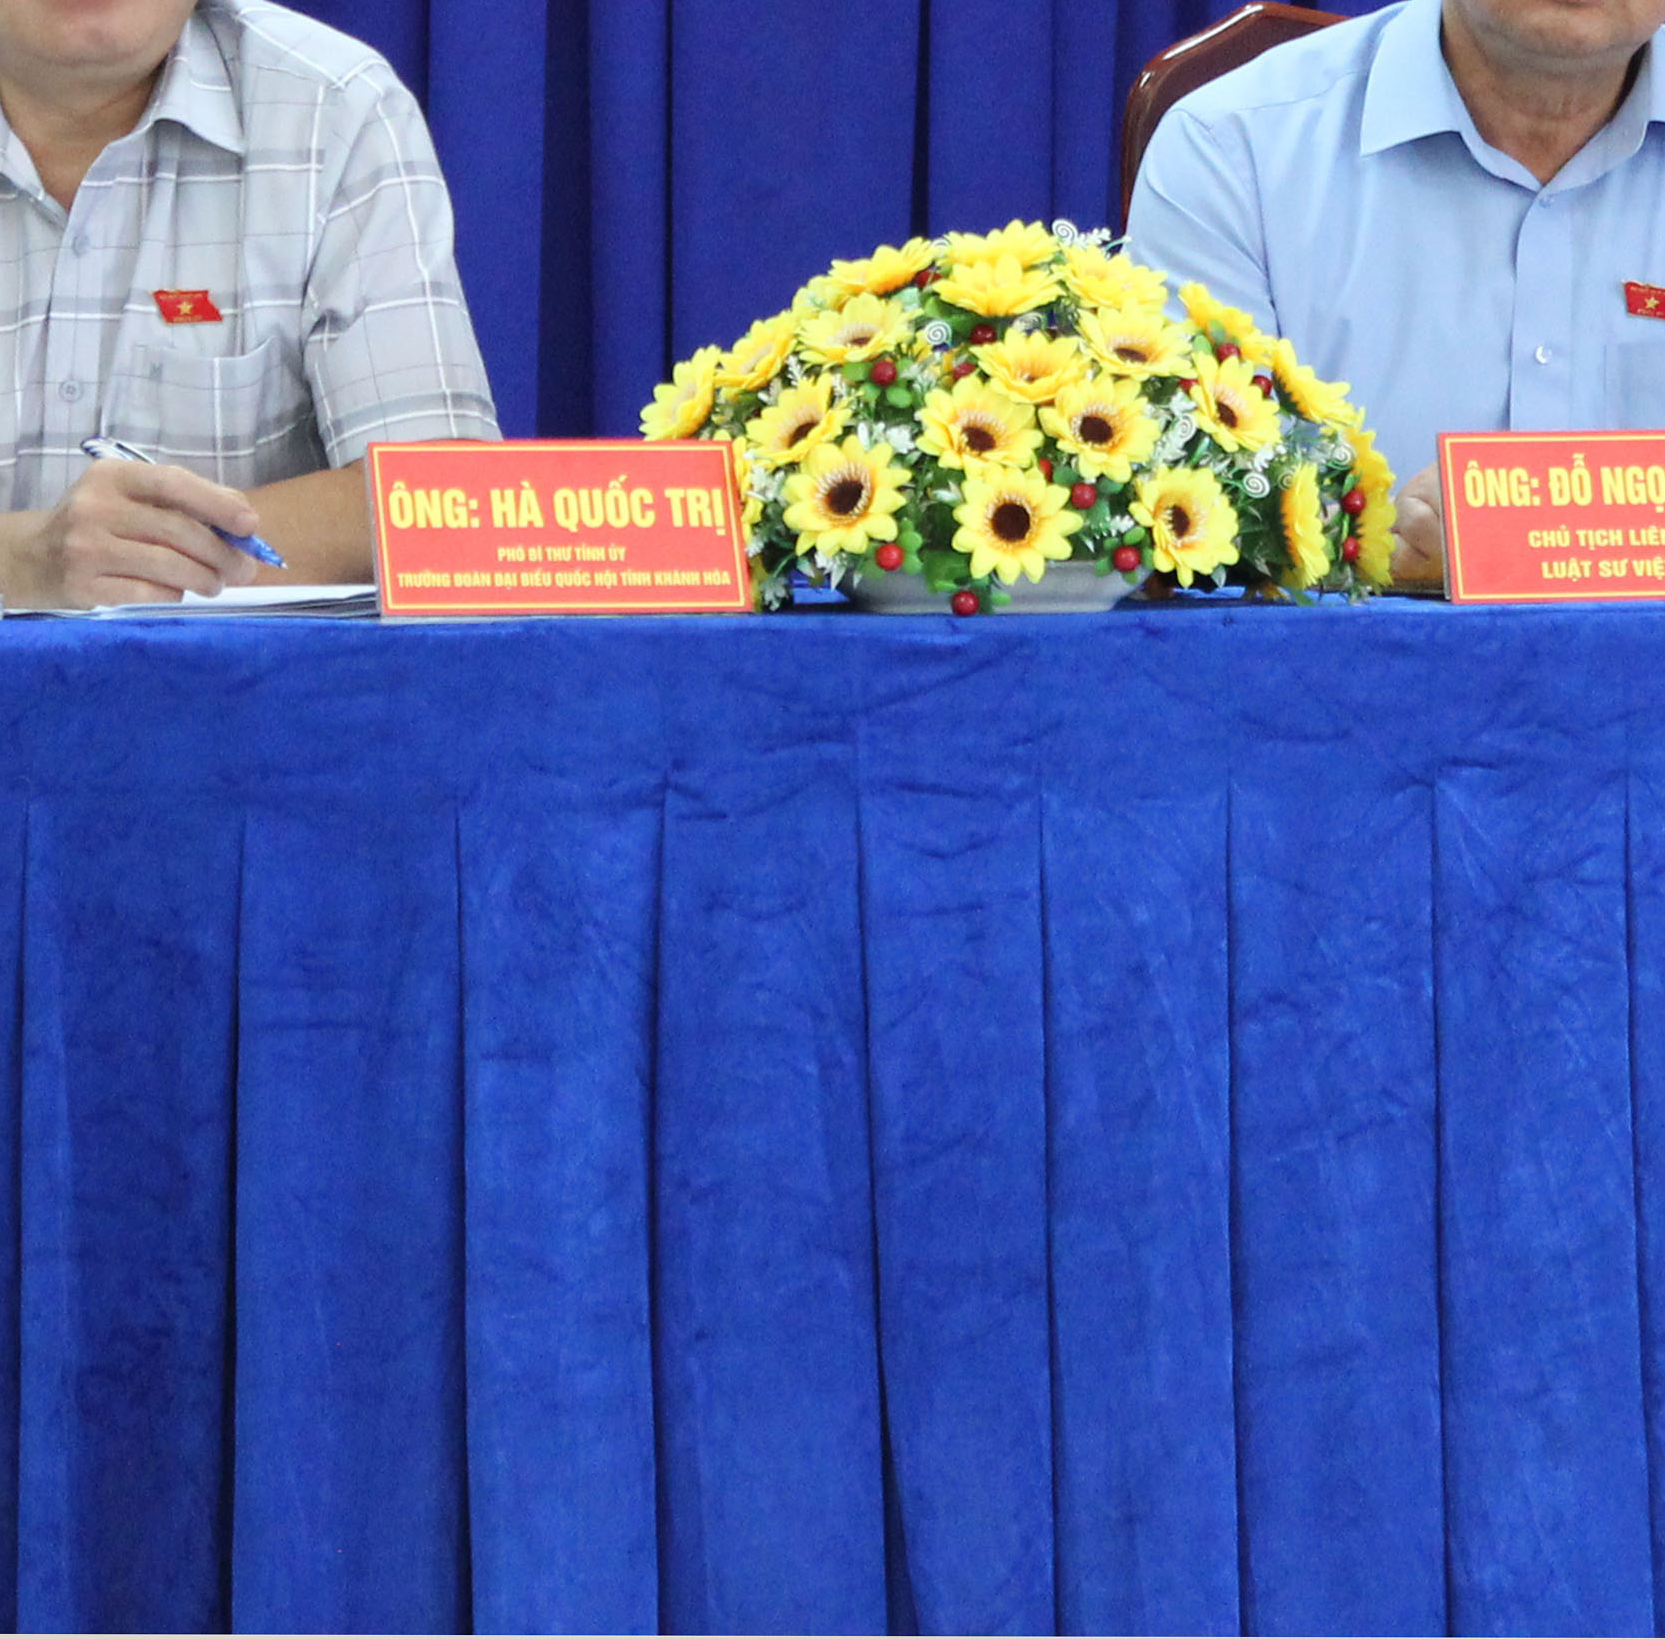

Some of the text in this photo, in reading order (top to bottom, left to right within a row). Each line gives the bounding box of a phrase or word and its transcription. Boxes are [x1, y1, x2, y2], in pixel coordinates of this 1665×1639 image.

[1464, 461, 1541, 508] ÔNG:
[1548, 453, 1593, 507] ĐỖ
[388, 475, 726, 535] ÔNG: HÀ QUỐC TRỊ
[1527, 524, 1571, 548] CHỦ
[1575, 528, 1624, 551] TỊCH
[497, 544, 526, 562] PHÓ
[1541, 557, 1592, 582] LUẬT
[1598, 558, 1629, 578] SƯ
